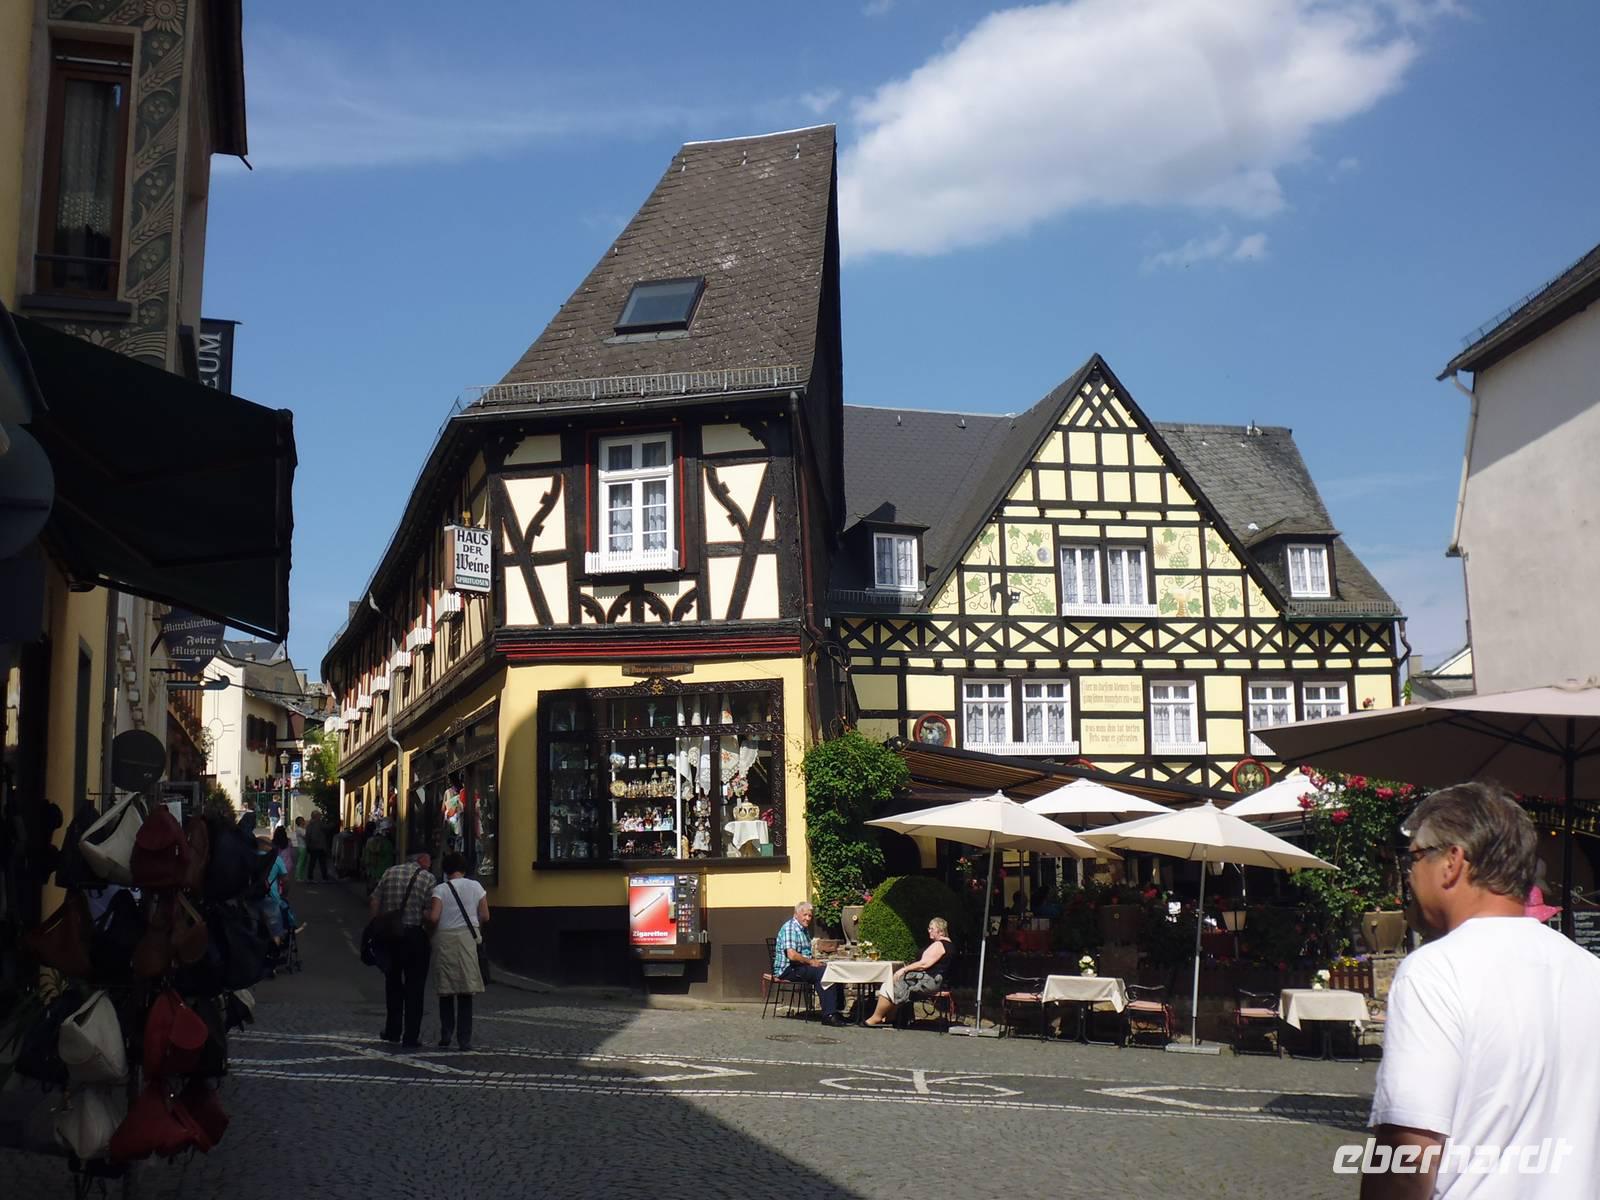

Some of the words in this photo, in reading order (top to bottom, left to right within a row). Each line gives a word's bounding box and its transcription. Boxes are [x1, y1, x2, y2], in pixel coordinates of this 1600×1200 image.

[457, 530, 489, 546] HAUS
[463, 544, 483, 556] DER
[456, 553, 490, 574] Weine
[456, 575, 489, 587] SPIRITUOSEN
[172, 646, 215, 656] Museum
[632, 930, 669, 938] Zigaretten
